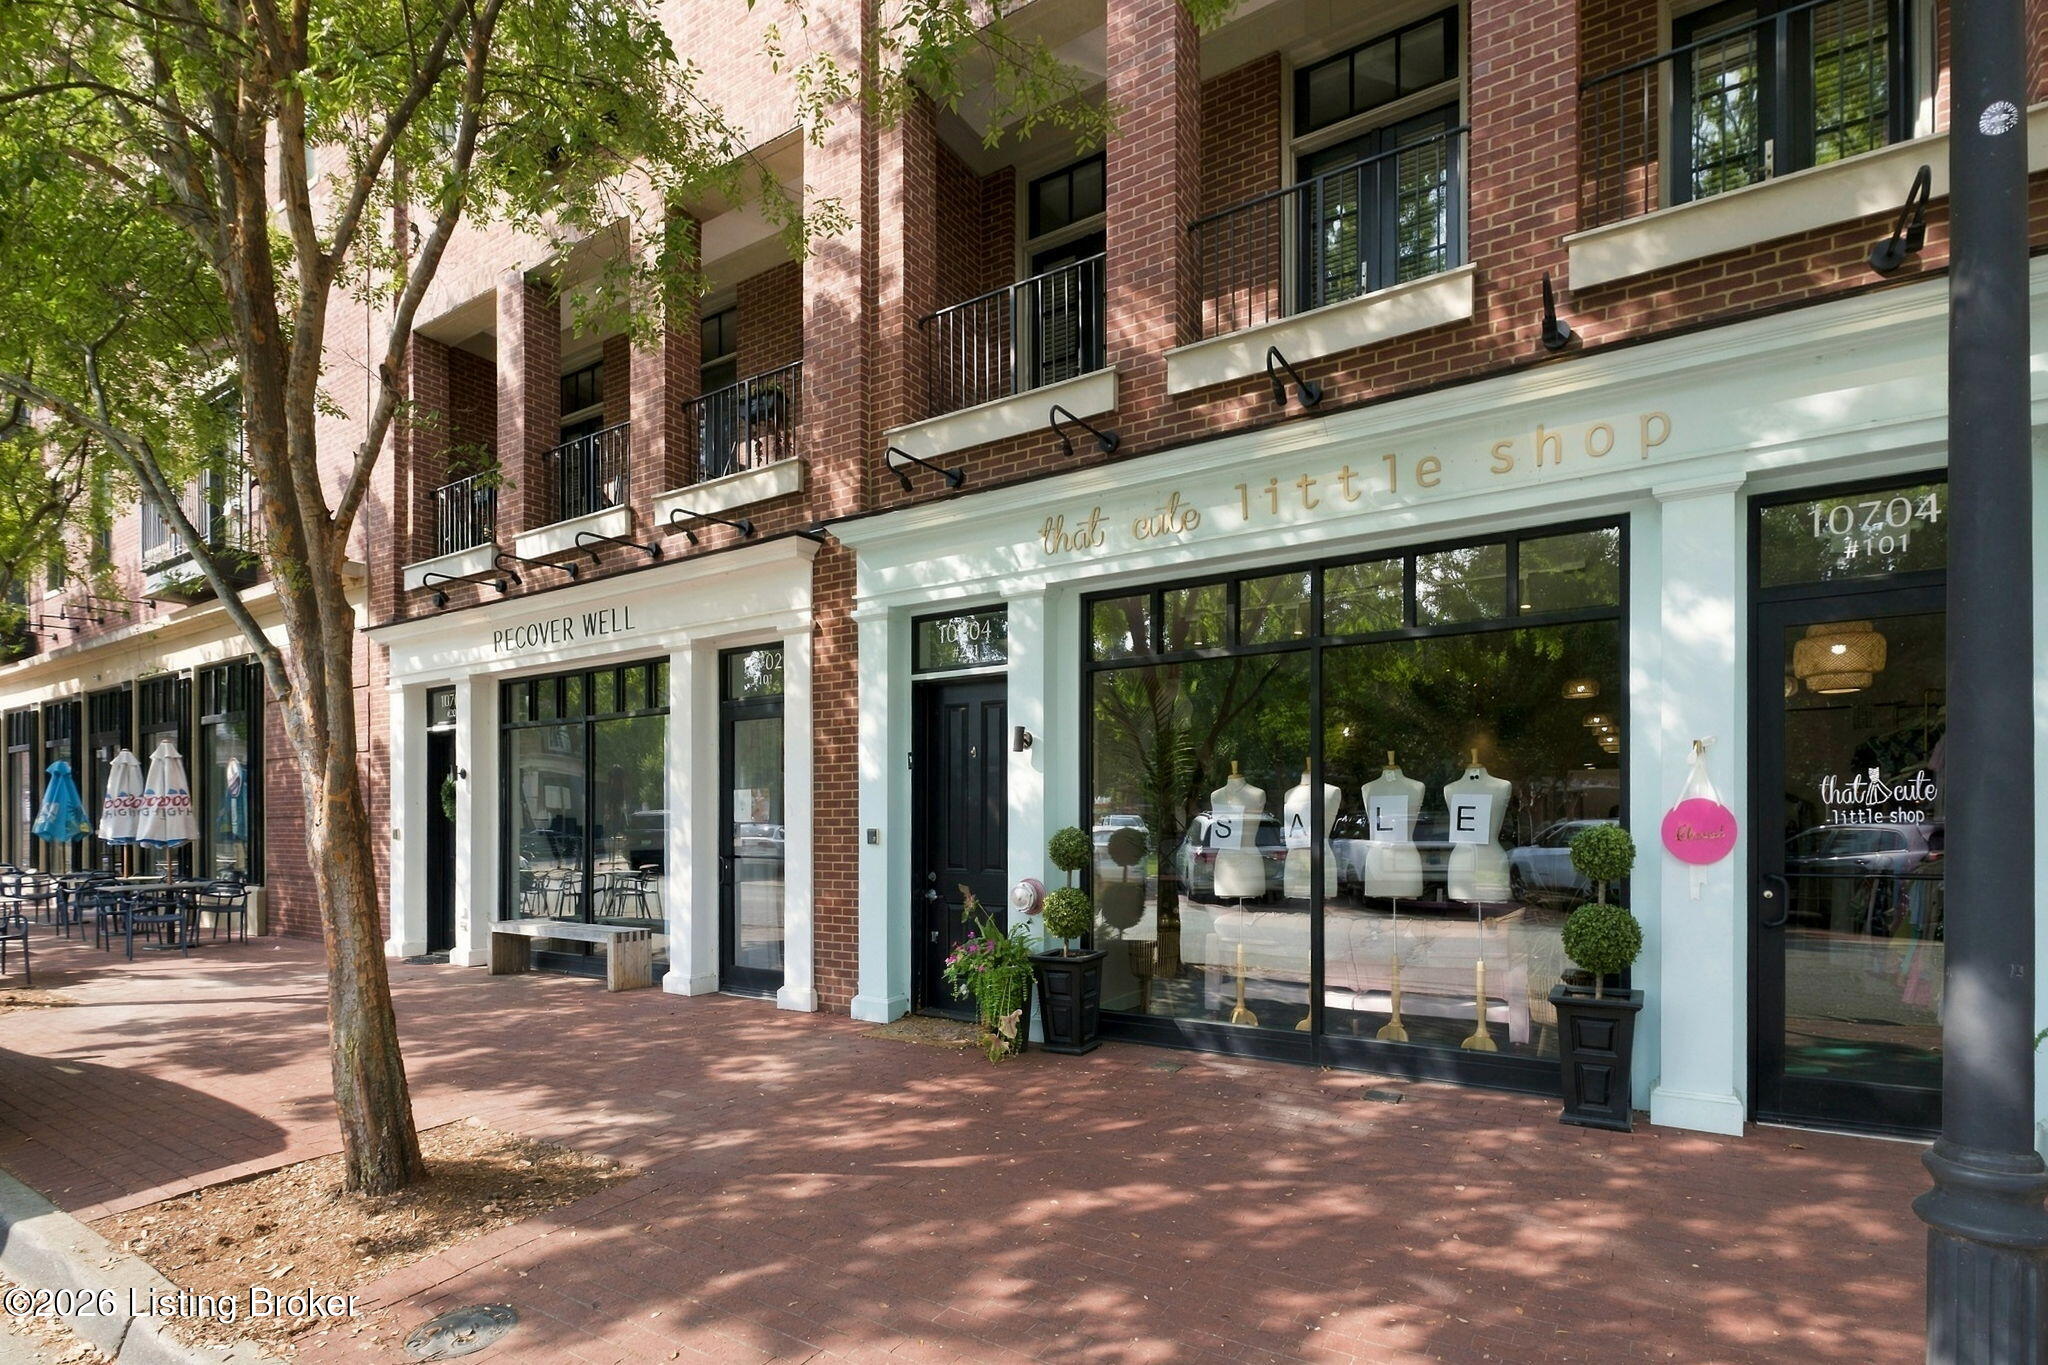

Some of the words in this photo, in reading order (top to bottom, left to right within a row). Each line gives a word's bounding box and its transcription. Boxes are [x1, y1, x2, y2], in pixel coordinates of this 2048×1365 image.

[1038, 506, 1110, 555] that
[1132, 491, 1201, 540] cute
[1234, 453, 1441, 521] little
[1490, 411, 1671, 474] shop
[1809, 493, 1941, 537] 10704
[1844, 534, 1908, 558] #101
[494, 617, 574, 652] RECOVER
[583, 606, 636, 637] WELL
[939, 619, 991, 643] 1004
[1819, 773, 1868, 804] that
[1893, 770, 1938, 802] cute
[1832, 808, 1882, 824] little
[1890, 807, 1925, 825] shop
